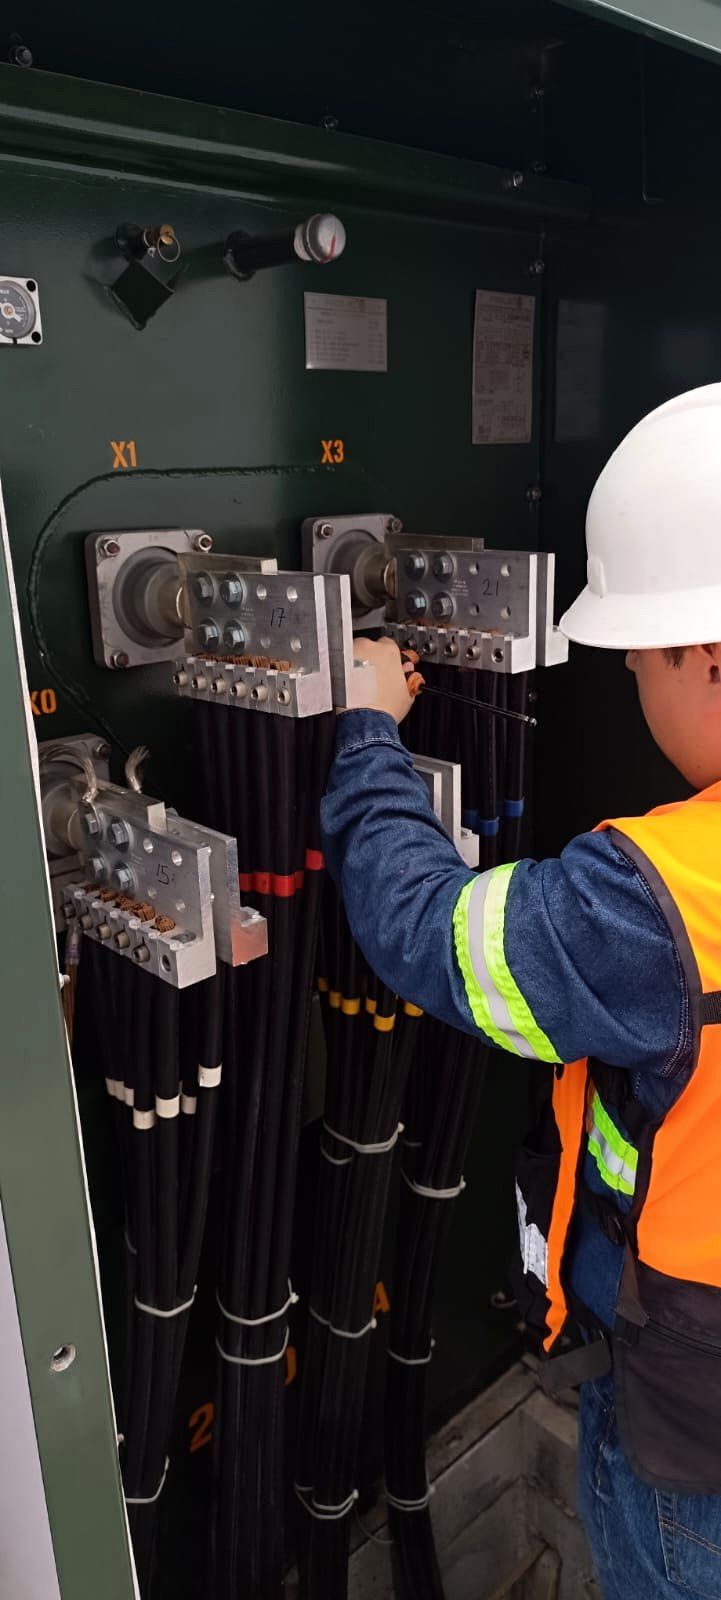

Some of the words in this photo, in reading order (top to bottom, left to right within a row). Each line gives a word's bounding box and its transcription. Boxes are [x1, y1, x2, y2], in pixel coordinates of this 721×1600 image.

[110, 441, 137, 468] X1
[321, 439, 345, 464] X3
[482, 578, 499, 597] 21
[270, 607, 287, 628] 17
